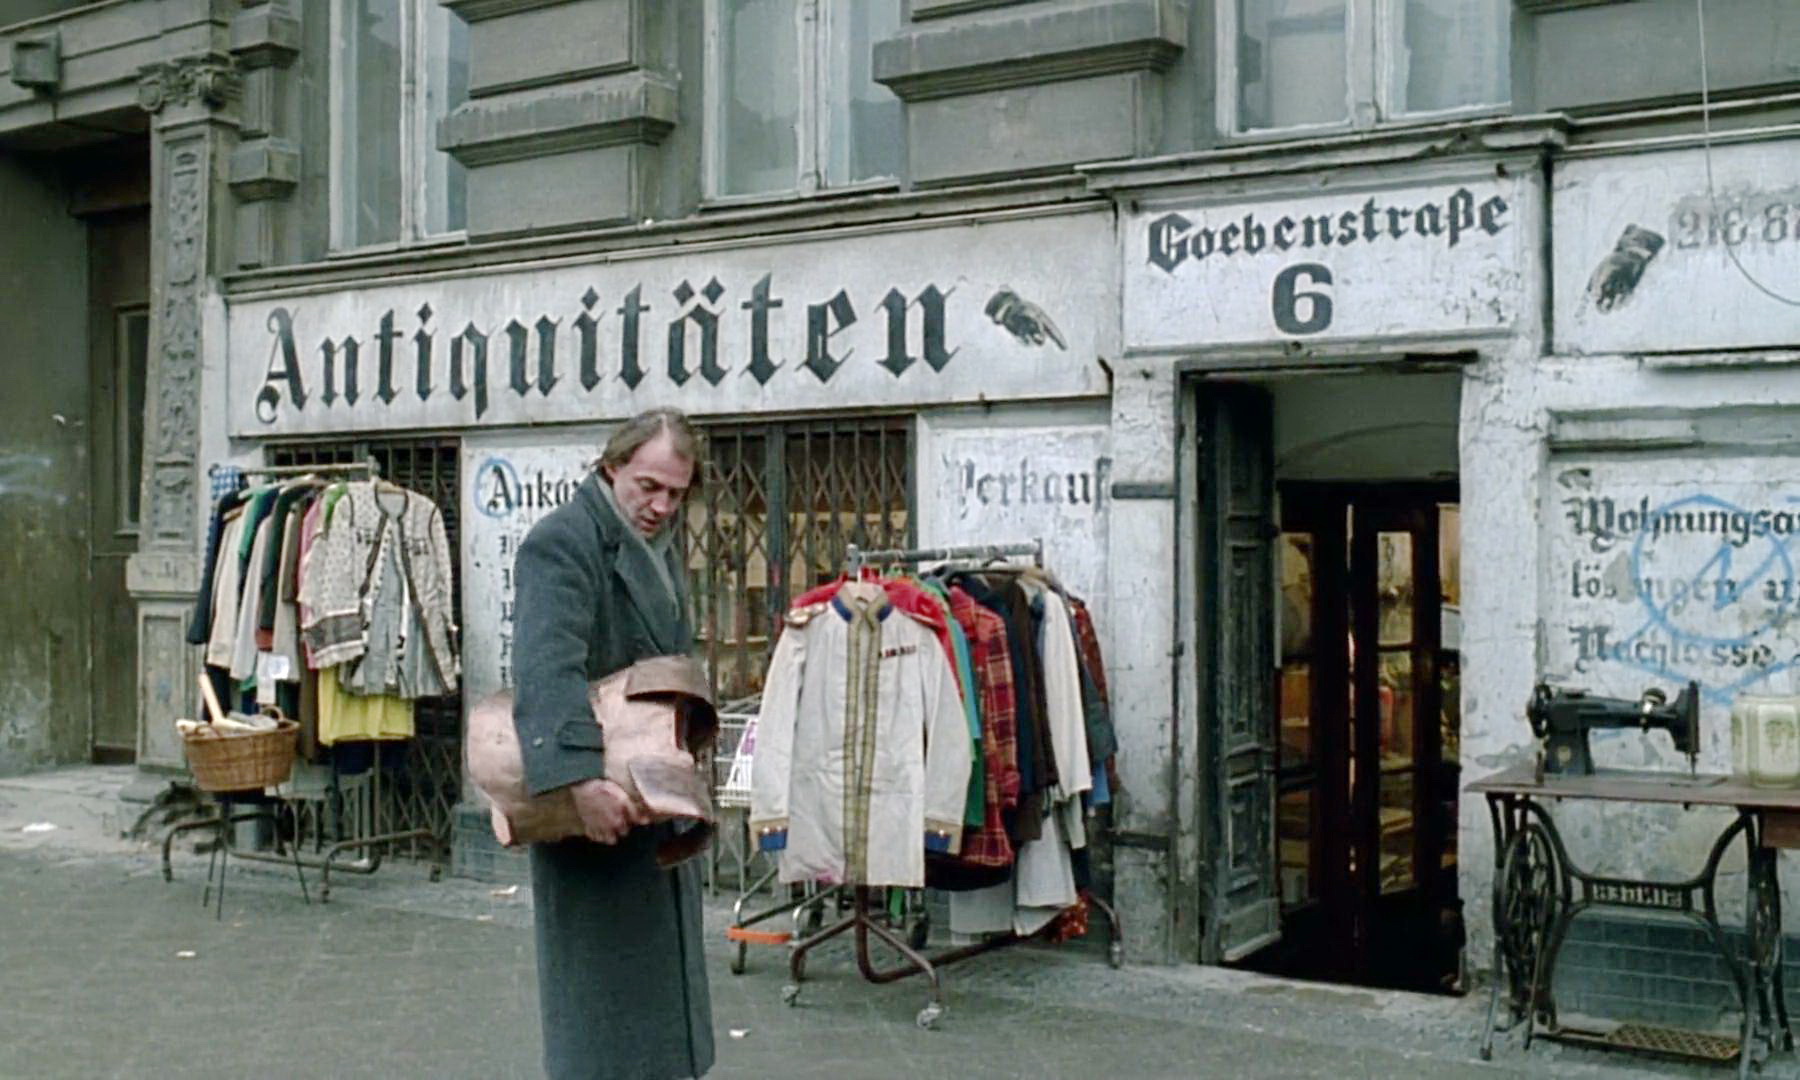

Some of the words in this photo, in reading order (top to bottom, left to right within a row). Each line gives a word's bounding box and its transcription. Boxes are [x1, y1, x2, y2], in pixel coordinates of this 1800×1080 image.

[1147, 187, 1510, 273] Goebenstraße
[1271, 262, 1335, 336] 6
[256, 271, 964, 424] Antiquitäten
[1562, 494, 1800, 553] Wohnungsa
